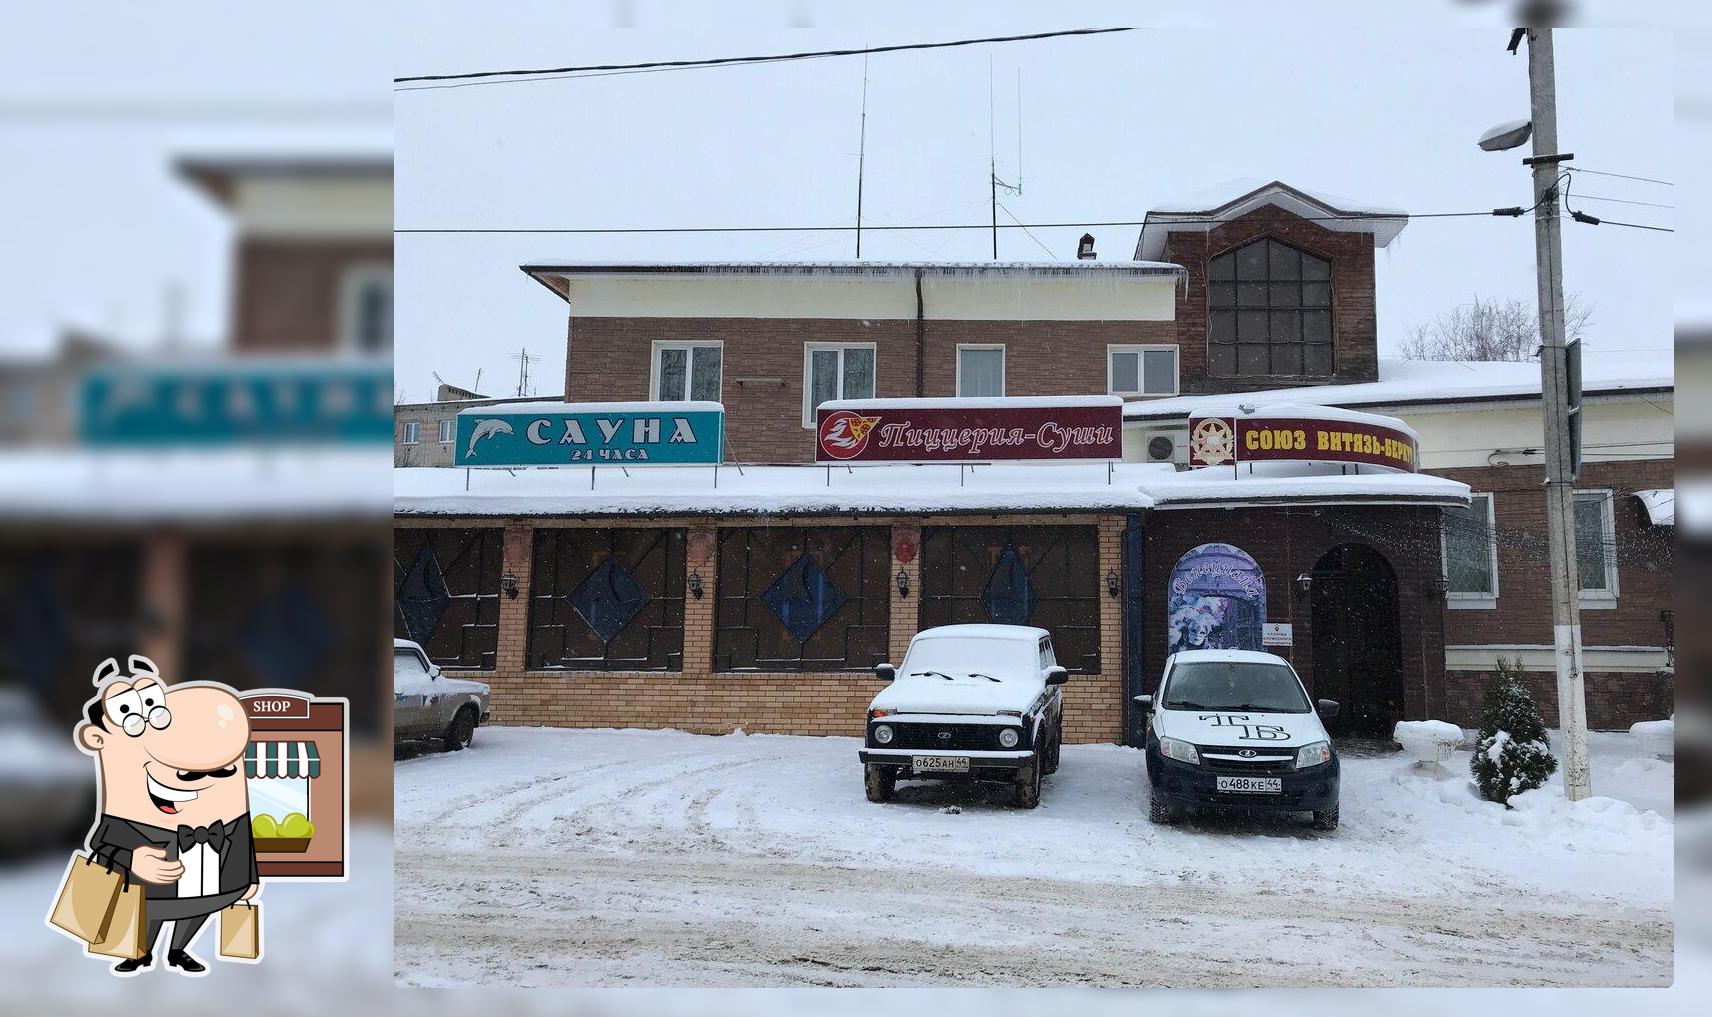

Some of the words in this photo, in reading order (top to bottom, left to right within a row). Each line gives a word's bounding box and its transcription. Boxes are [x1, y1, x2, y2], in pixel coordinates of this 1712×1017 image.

[525, 418, 697, 445] САУНА
[878, 420, 1113, 454] Пиццерия-Суши
[1245, 430, 1306, 451] СОЮЗ
[570, 449, 594, 461] 24
[598, 448, 649, 461] ЧАСА
